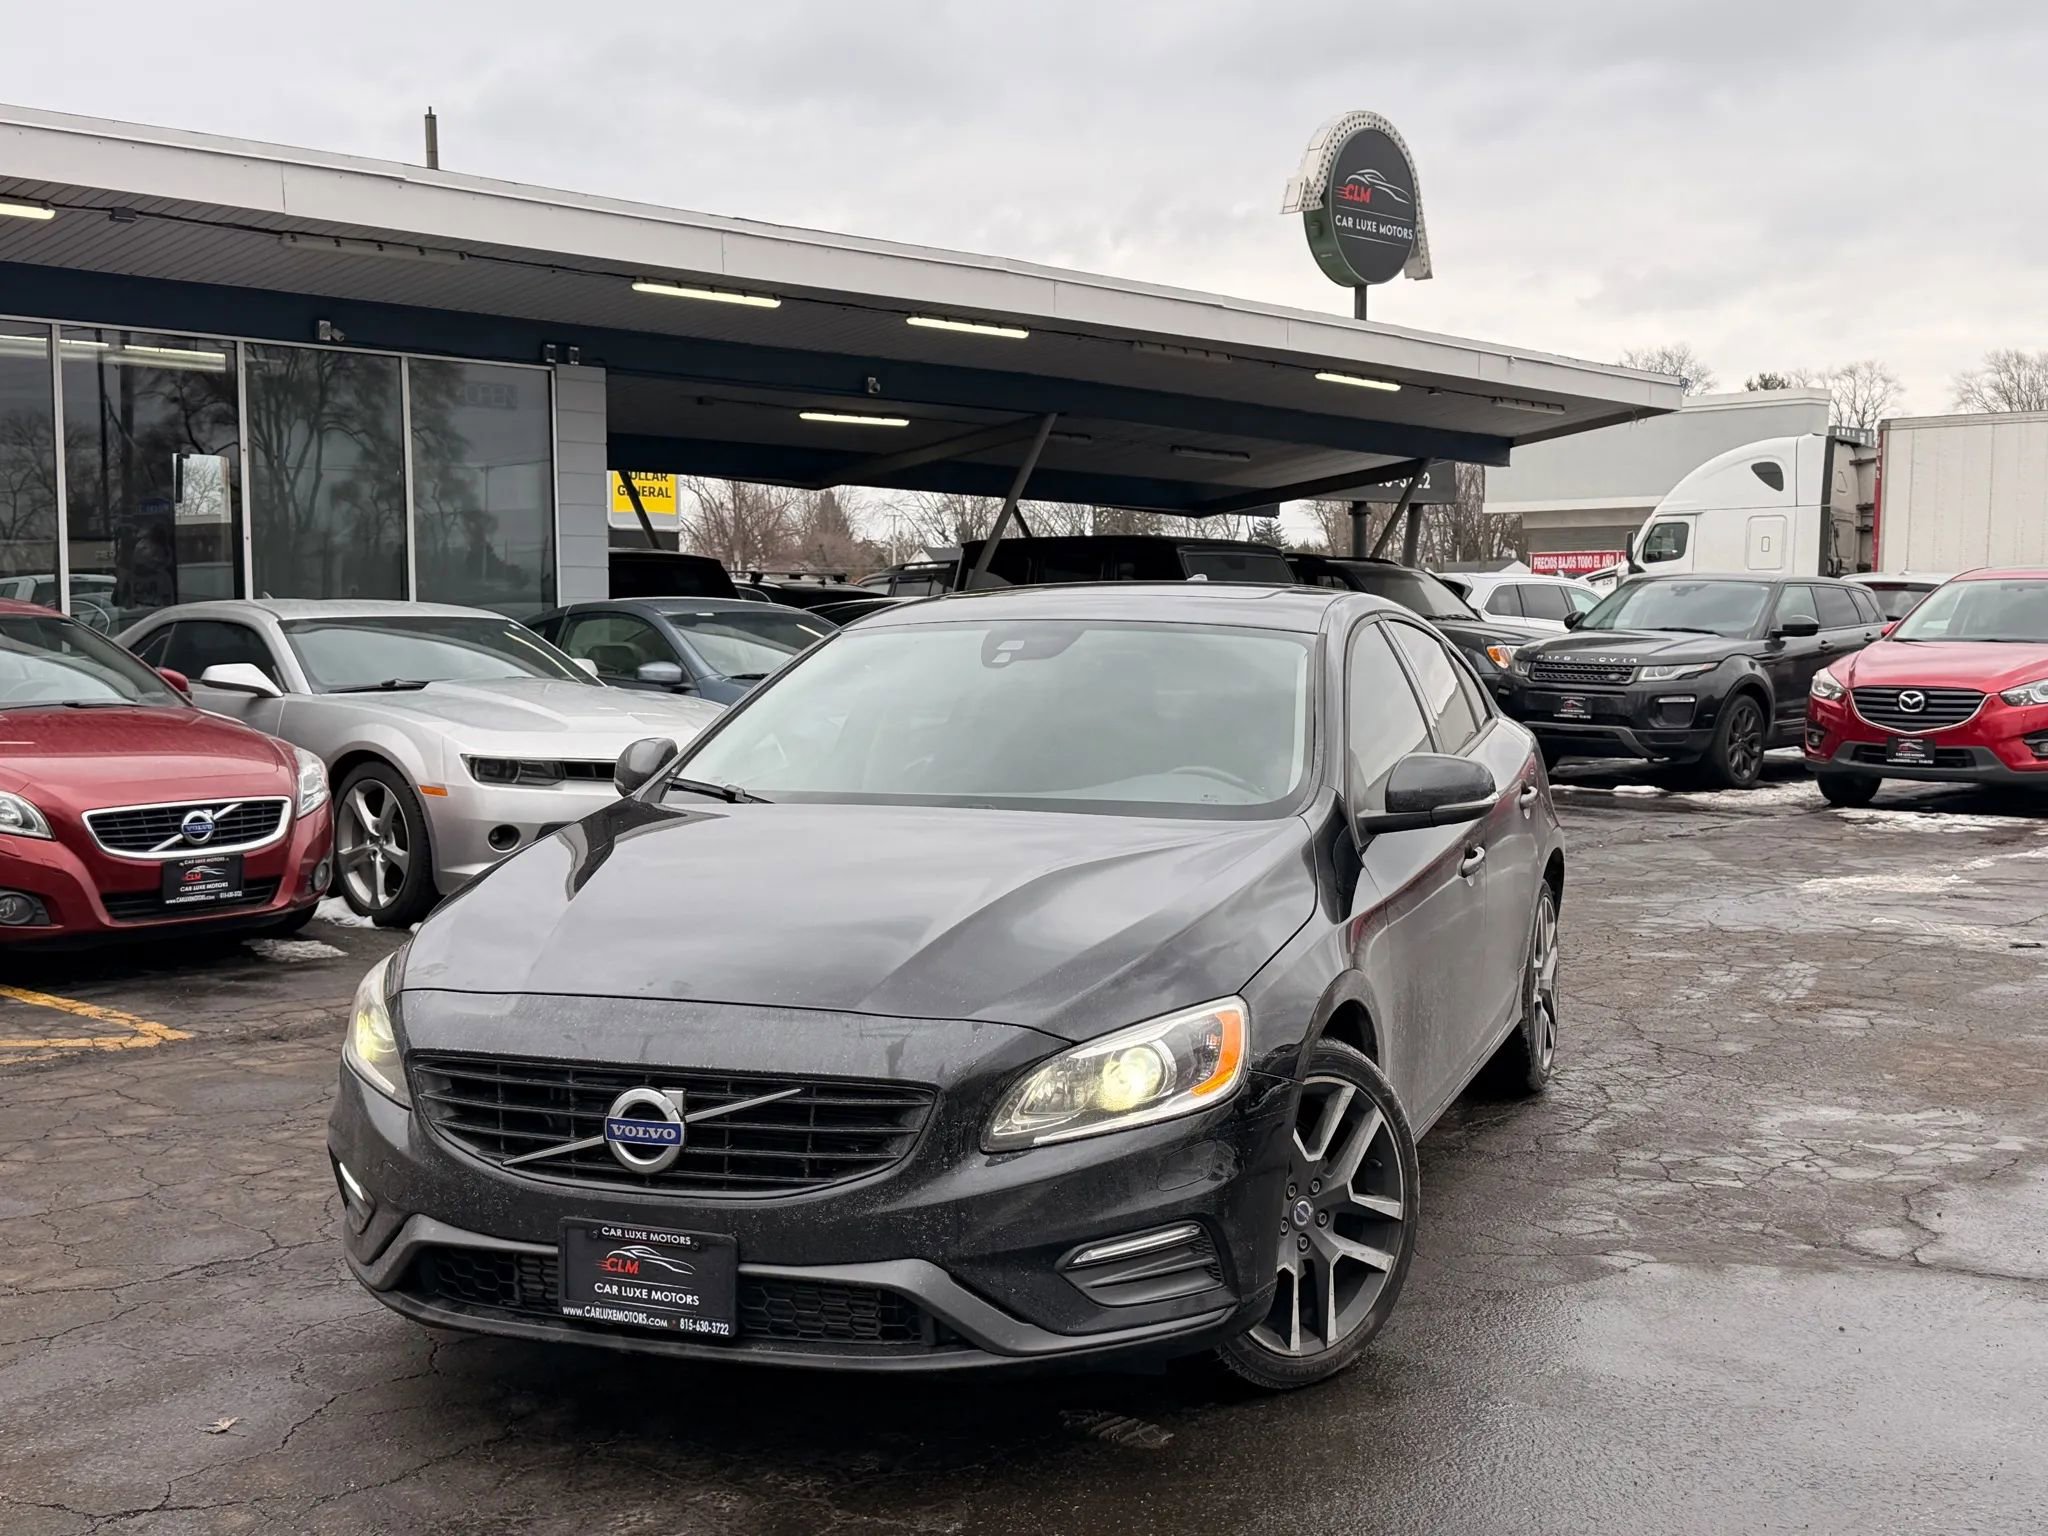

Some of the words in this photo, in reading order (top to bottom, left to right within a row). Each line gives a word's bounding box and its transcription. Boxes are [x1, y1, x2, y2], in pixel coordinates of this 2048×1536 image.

[1343, 183, 1372, 203] CLM
[1335, 214, 1353, 228] CAR
[1356, 218, 1378, 233] LUXE
[1379, 223, 1414, 240] MOTORS
[629, 471, 669, 482] OLLAR
[617, 484, 672, 498] GERAL
[1533, 556, 1557, 570] PRECIOS
[1558, 555, 1577, 569] BAJOS
[1577, 555, 1593, 569] TODO
[1594, 555, 1601, 568] EL
[1601, 553, 1615, 568] AÑO
[610, 1124, 676, 1140] VOLVO
[601, 1226, 622, 1237] CAR
[624, 1230, 648, 1240] LUXE
[649, 1233, 692, 1245] MOTORS
[606, 1257, 640, 1274] CLM
[594, 1282, 619, 1295] CAR
[621, 1286, 649, 1299] LUXE
[651, 1291, 700, 1306] MOTORS
[679, 1317, 729, 1335] 815-630-3722
